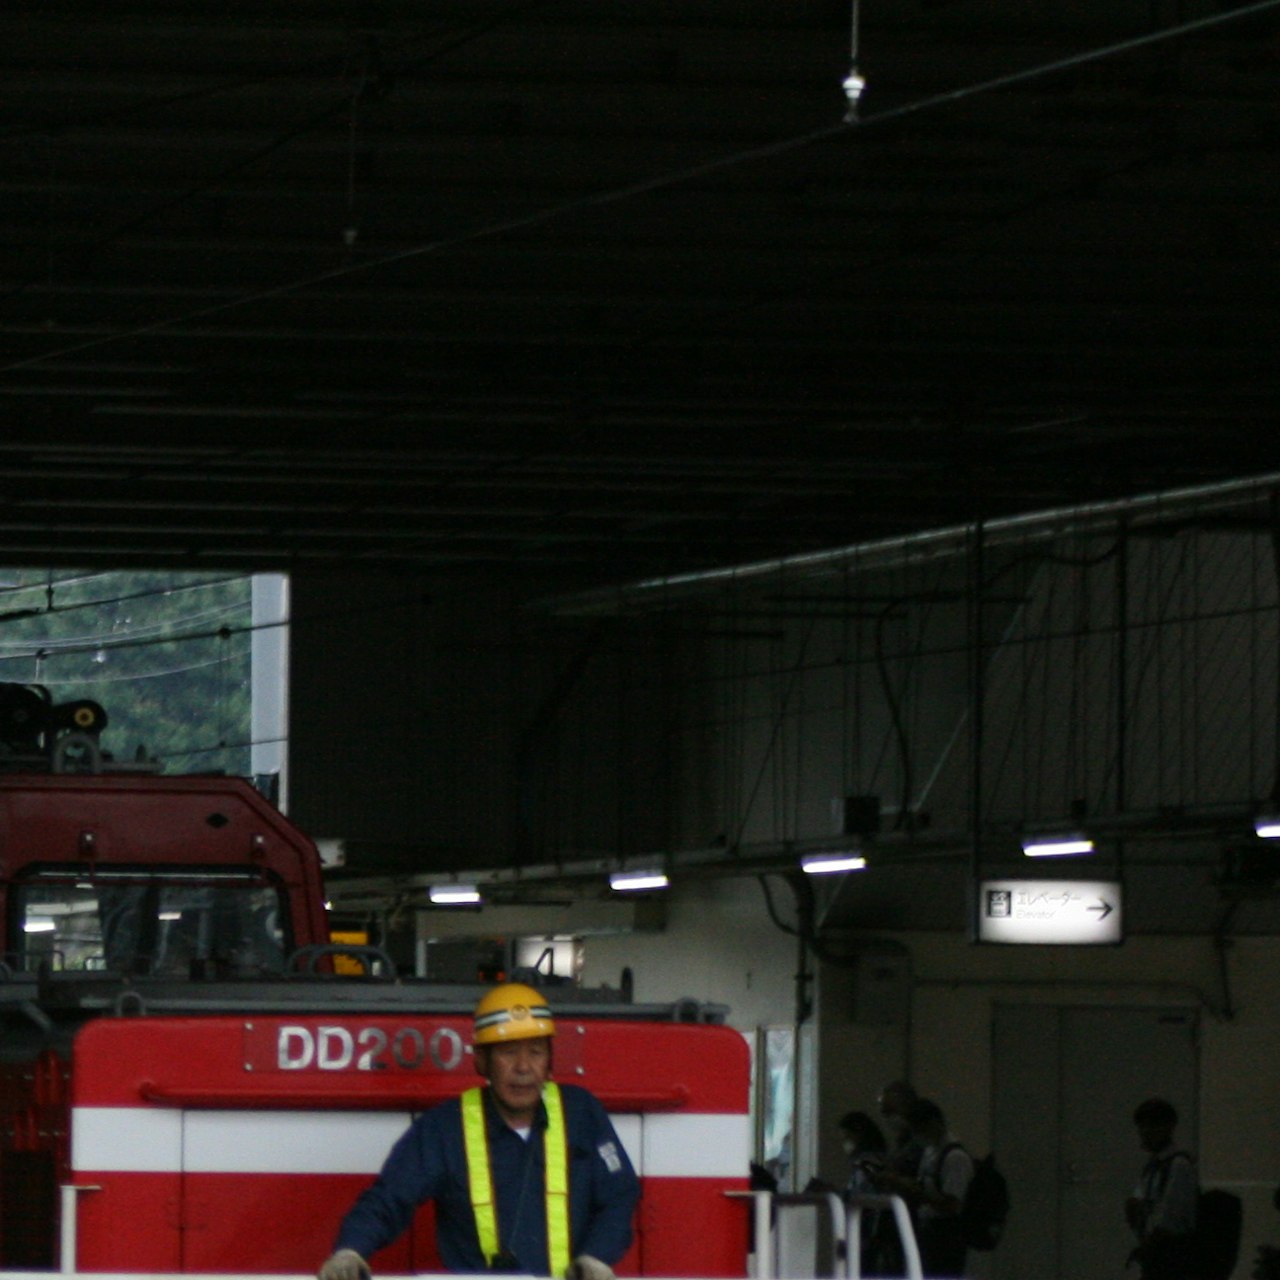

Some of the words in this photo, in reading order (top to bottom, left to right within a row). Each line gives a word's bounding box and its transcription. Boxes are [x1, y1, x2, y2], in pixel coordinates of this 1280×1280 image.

[1017, 889, 1082, 907] エレベーター
[1016, 910, 1056, 920] Elevator
